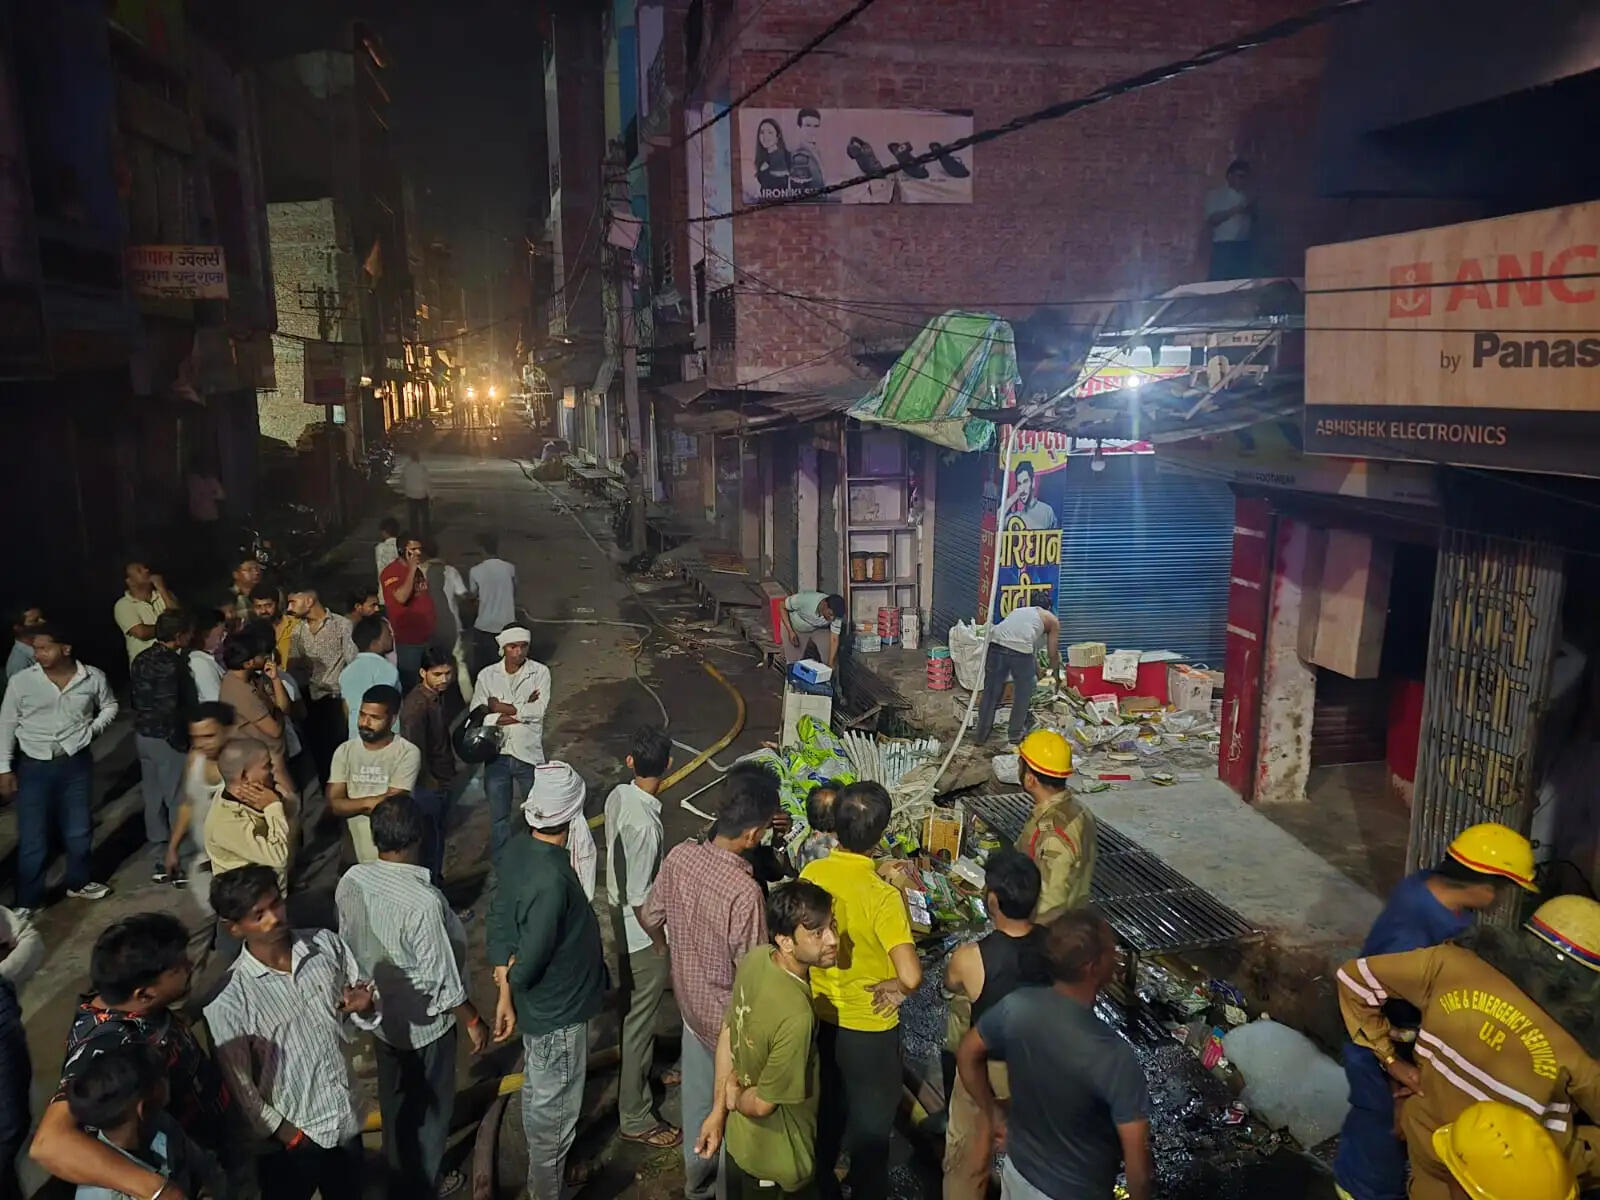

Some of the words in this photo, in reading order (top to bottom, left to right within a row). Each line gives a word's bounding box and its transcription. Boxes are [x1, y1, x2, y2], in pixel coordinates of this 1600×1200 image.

[1446, 245, 1597, 312] ANC
[1440, 351, 1462, 374] by
[1473, 332, 1600, 369] Panas
[1316, 419, 1387, 438] ABHISHEK
[1390, 422, 1507, 447] ELECTRONICS
[1440, 990, 1462, 1015] FIRE
[1462, 989, 1470, 1009] &
[1472, 990, 1533, 1034] EMERGENCY
[1520, 1028, 1557, 1080] SERVICES
[1478, 1021, 1508, 1052] U.P.
